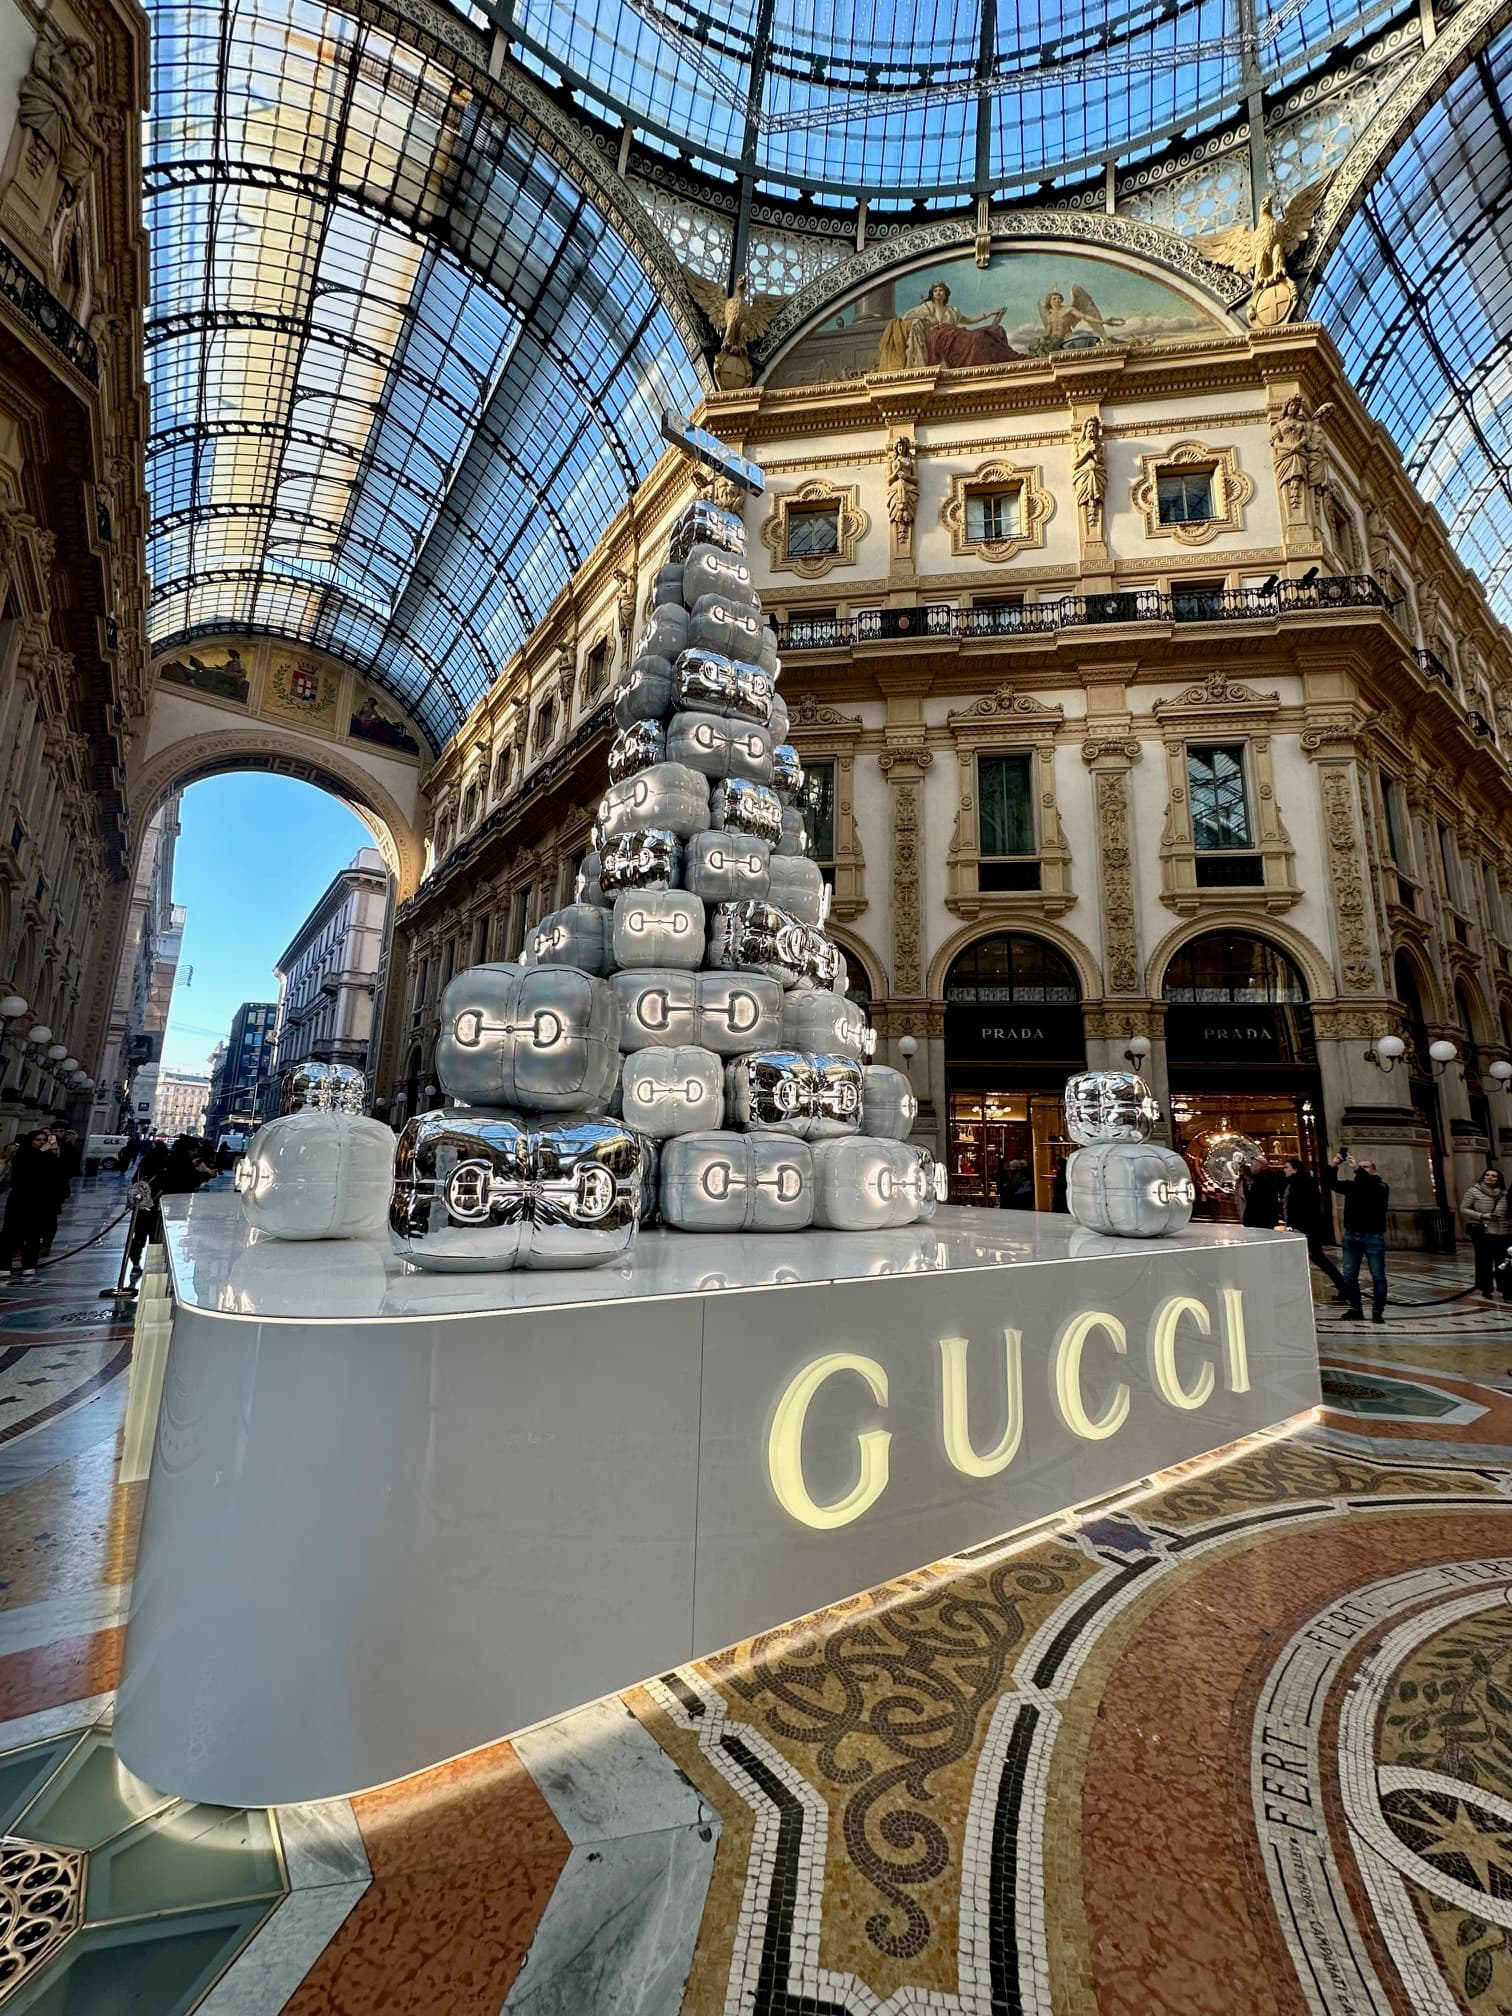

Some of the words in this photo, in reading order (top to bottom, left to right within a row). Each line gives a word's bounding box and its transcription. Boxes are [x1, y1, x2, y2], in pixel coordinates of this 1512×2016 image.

[981, 1027, 1044, 1039] PRADA
[1204, 1027, 1272, 1040] PRADA
[765, 1287, 1252, 1530] GUCCI
[1304, 1601, 1376, 1651] FERT
[1261, 1726, 1318, 1836] FERT
